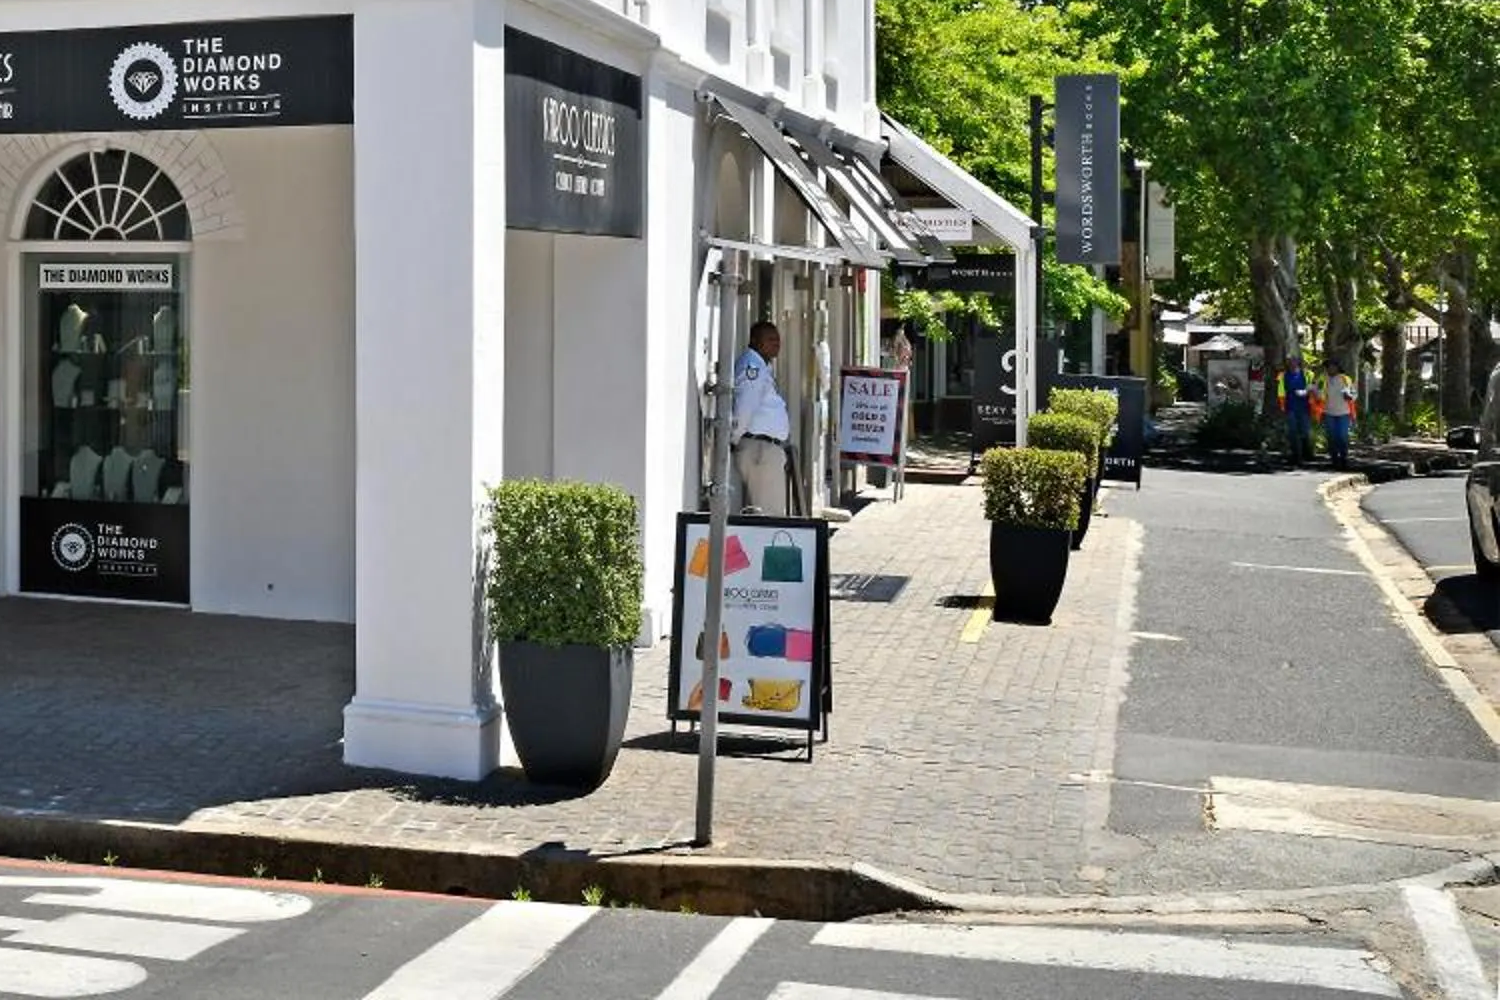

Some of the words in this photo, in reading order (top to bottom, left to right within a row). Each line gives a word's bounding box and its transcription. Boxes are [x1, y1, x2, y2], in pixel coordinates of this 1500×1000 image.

[182, 37, 224, 54] THE
[182, 53, 283, 74] DIAMOND
[182, 73, 261, 93] WORKS
[182, 101, 282, 113] INSTITUTE
[1081, 133, 1093, 254] WORDSWORTH
[43, 269, 64, 283] THE
[68, 269, 122, 283] DIAMOND
[126, 269, 169, 283] WORKS
[848, 381, 894, 397] SALE
[97, 523, 124, 535] THE
[97, 535, 159, 549] DIAMOND
[97, 547, 145, 560] WORKS
